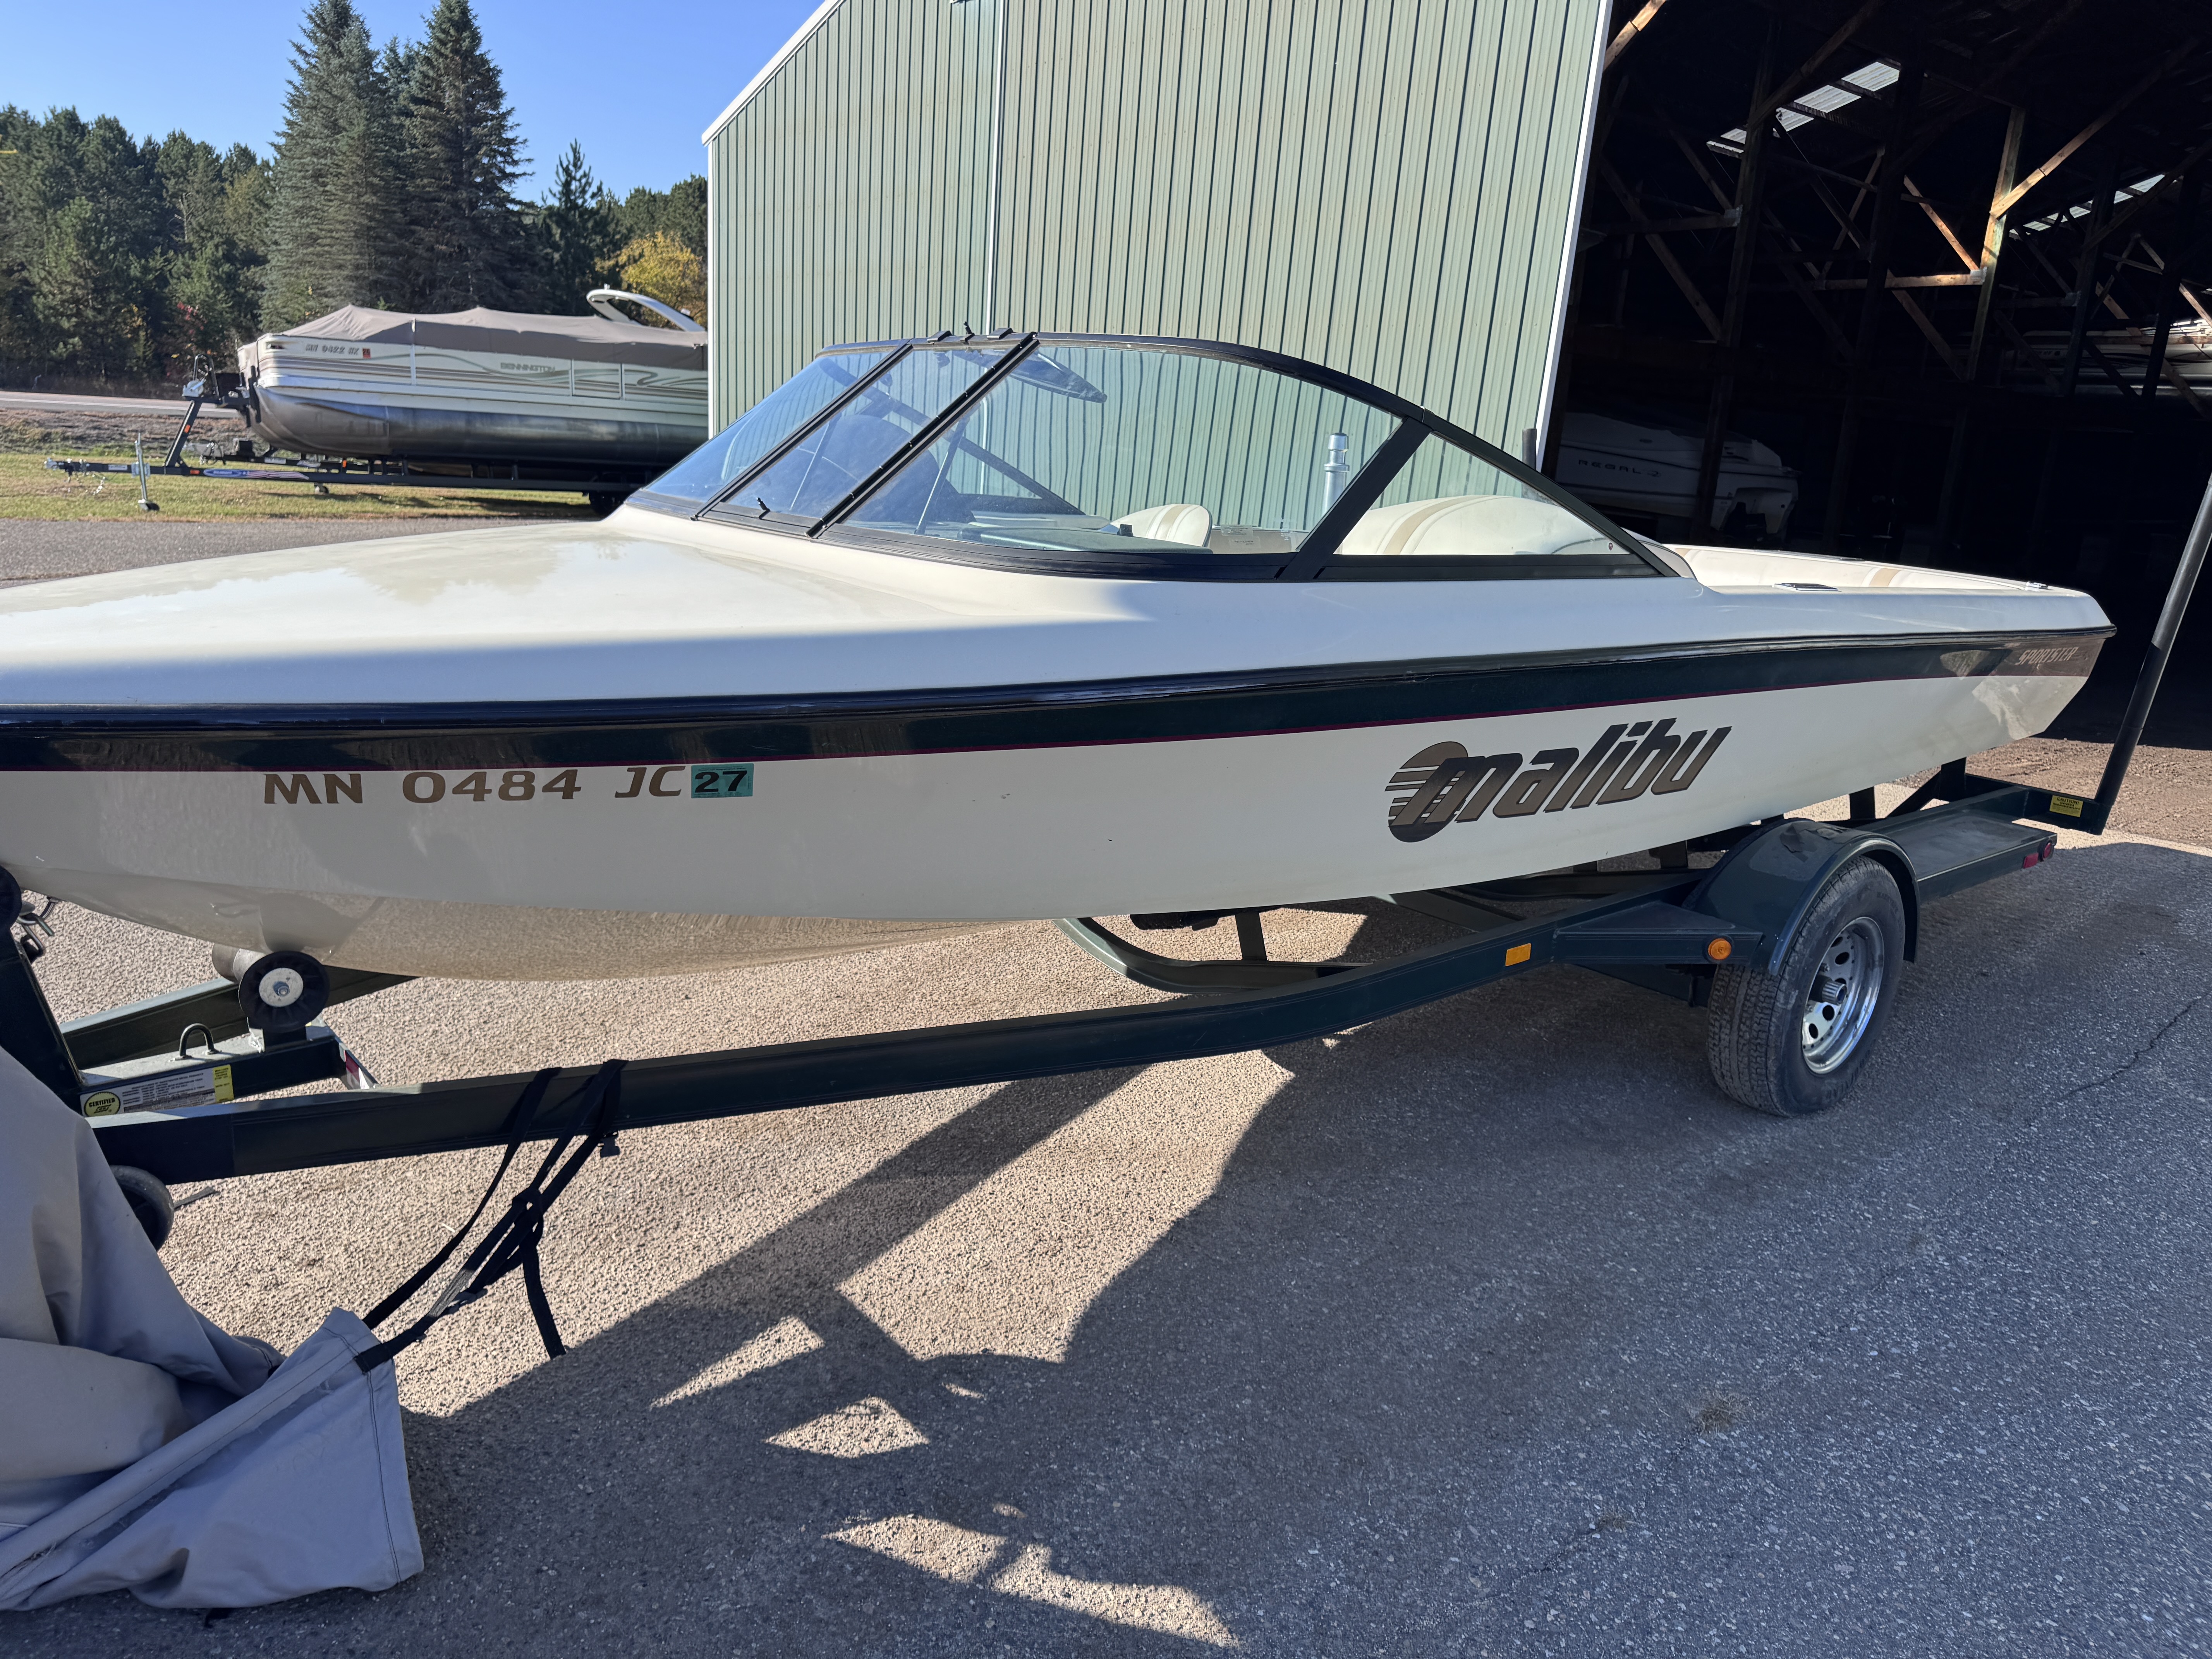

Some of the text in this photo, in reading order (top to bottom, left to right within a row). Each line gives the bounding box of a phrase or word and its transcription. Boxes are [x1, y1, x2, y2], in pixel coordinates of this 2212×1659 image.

[306, 344, 318, 352] MN
[1578, 460, 1641, 474] REGAL
[2014, 647, 2079, 665] SPORTSTER
[1391, 718, 1732, 826] malibu
[264, 765, 686, 804] MN 0484 JC
[695, 770, 748, 793] 27
[89, 1097, 115, 1108] CERTIFIED
